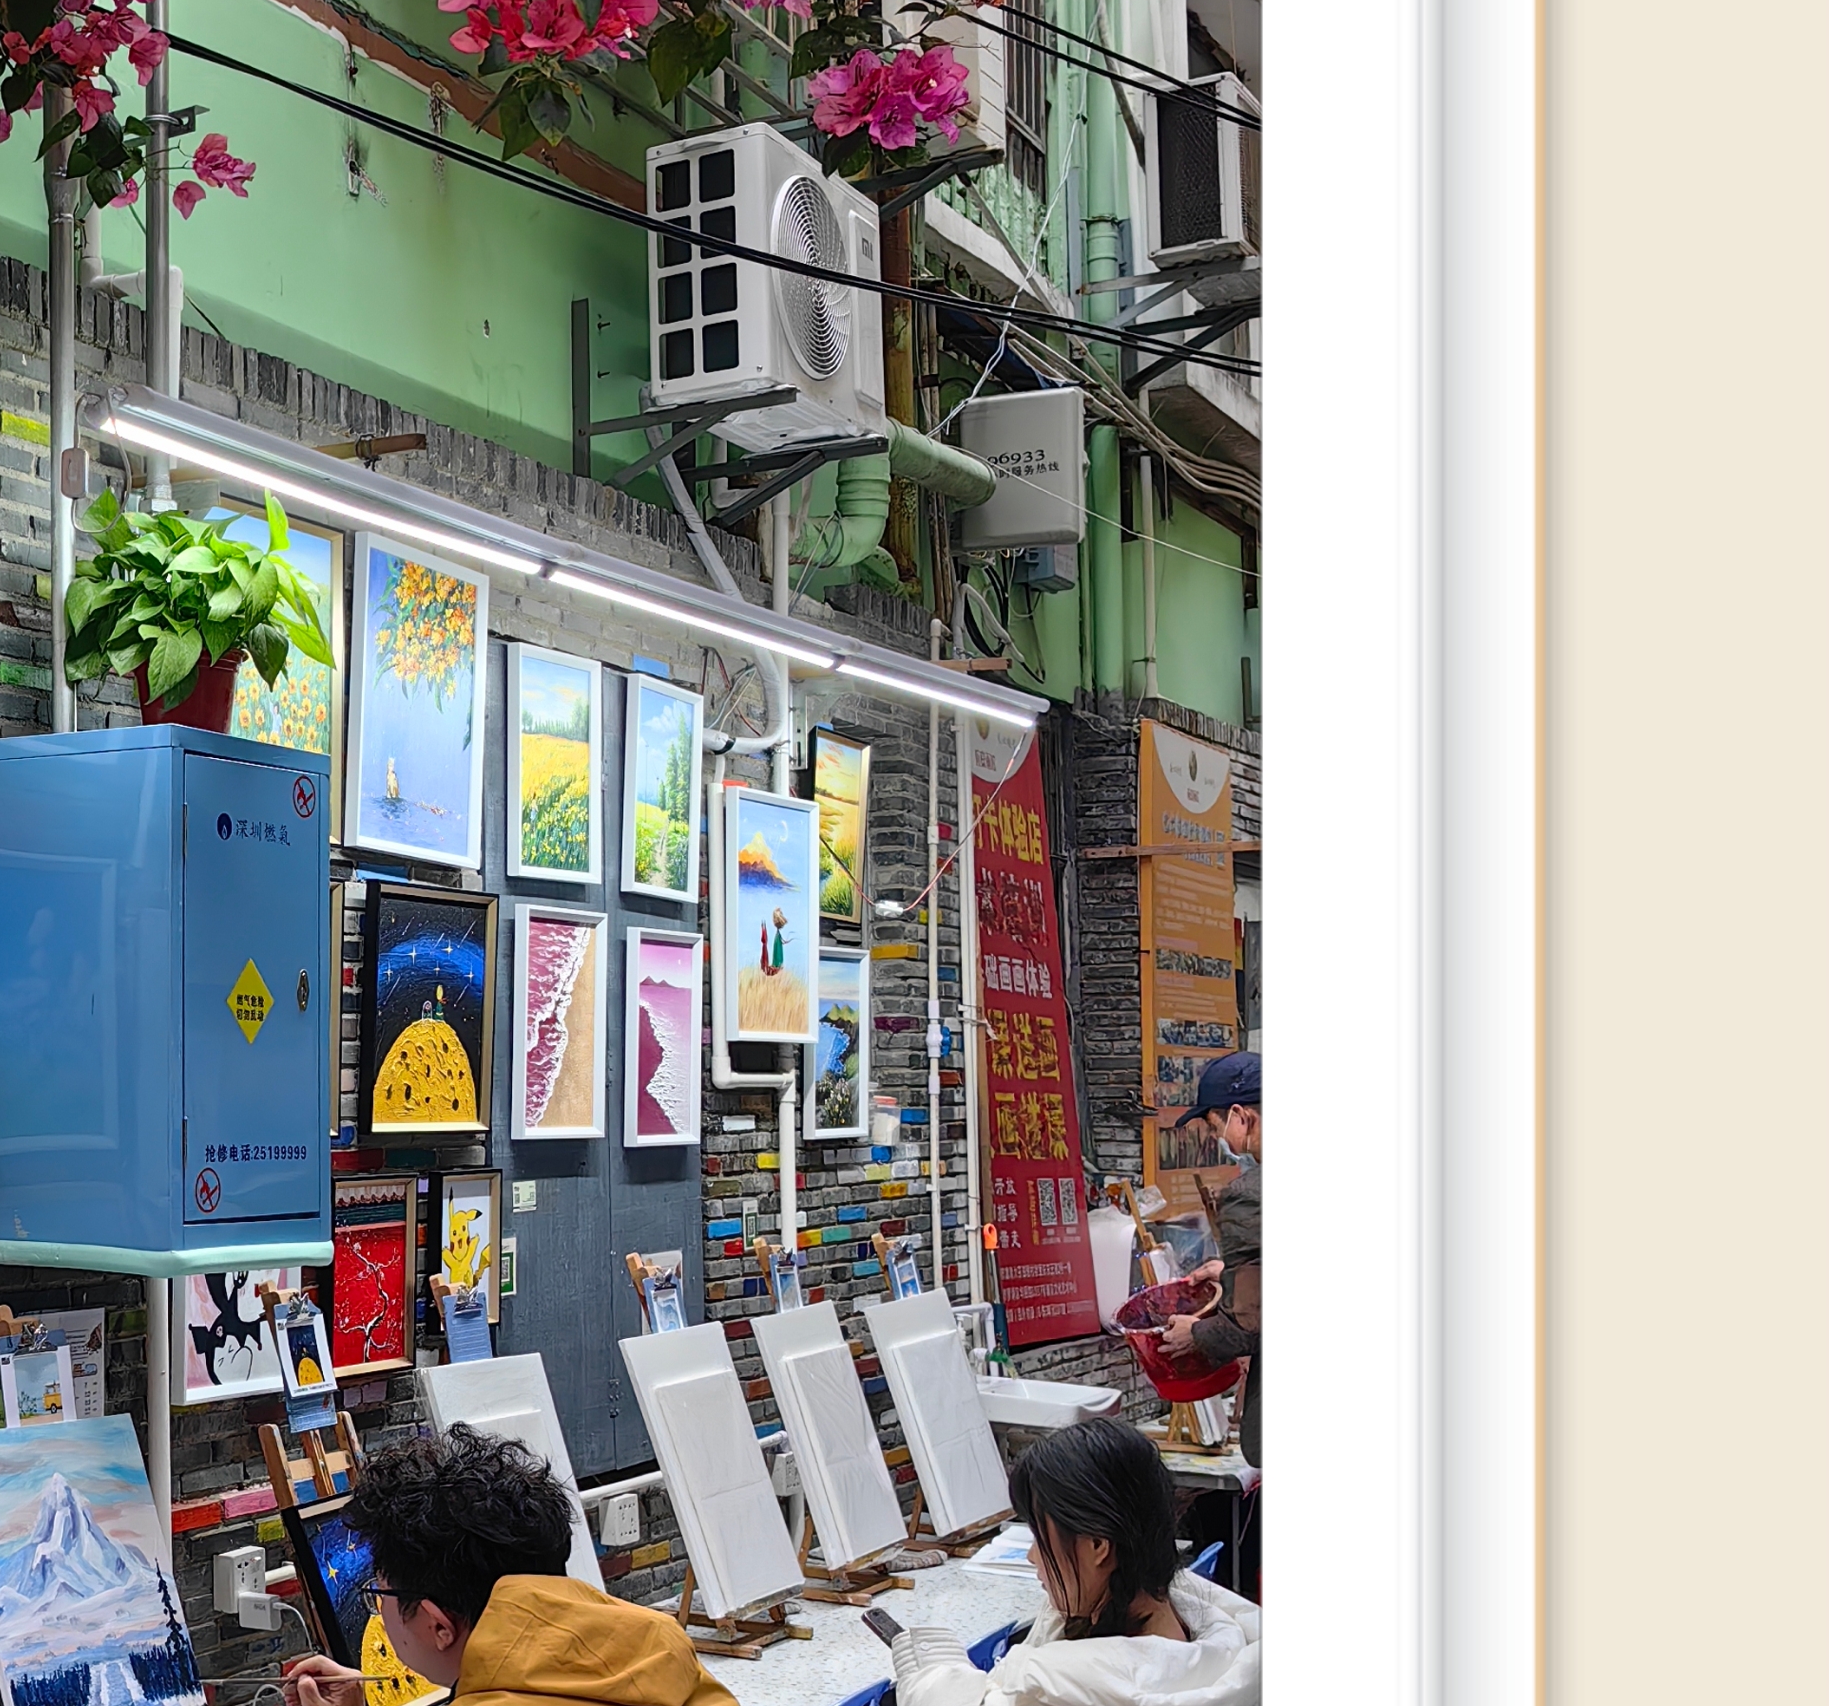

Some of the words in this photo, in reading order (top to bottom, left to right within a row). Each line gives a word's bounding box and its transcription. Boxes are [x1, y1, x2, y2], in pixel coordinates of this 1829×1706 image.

[994, 461, 1060, 479] 时服务热线
[205, 1144, 307, 1163] 抢修电话:25199999
